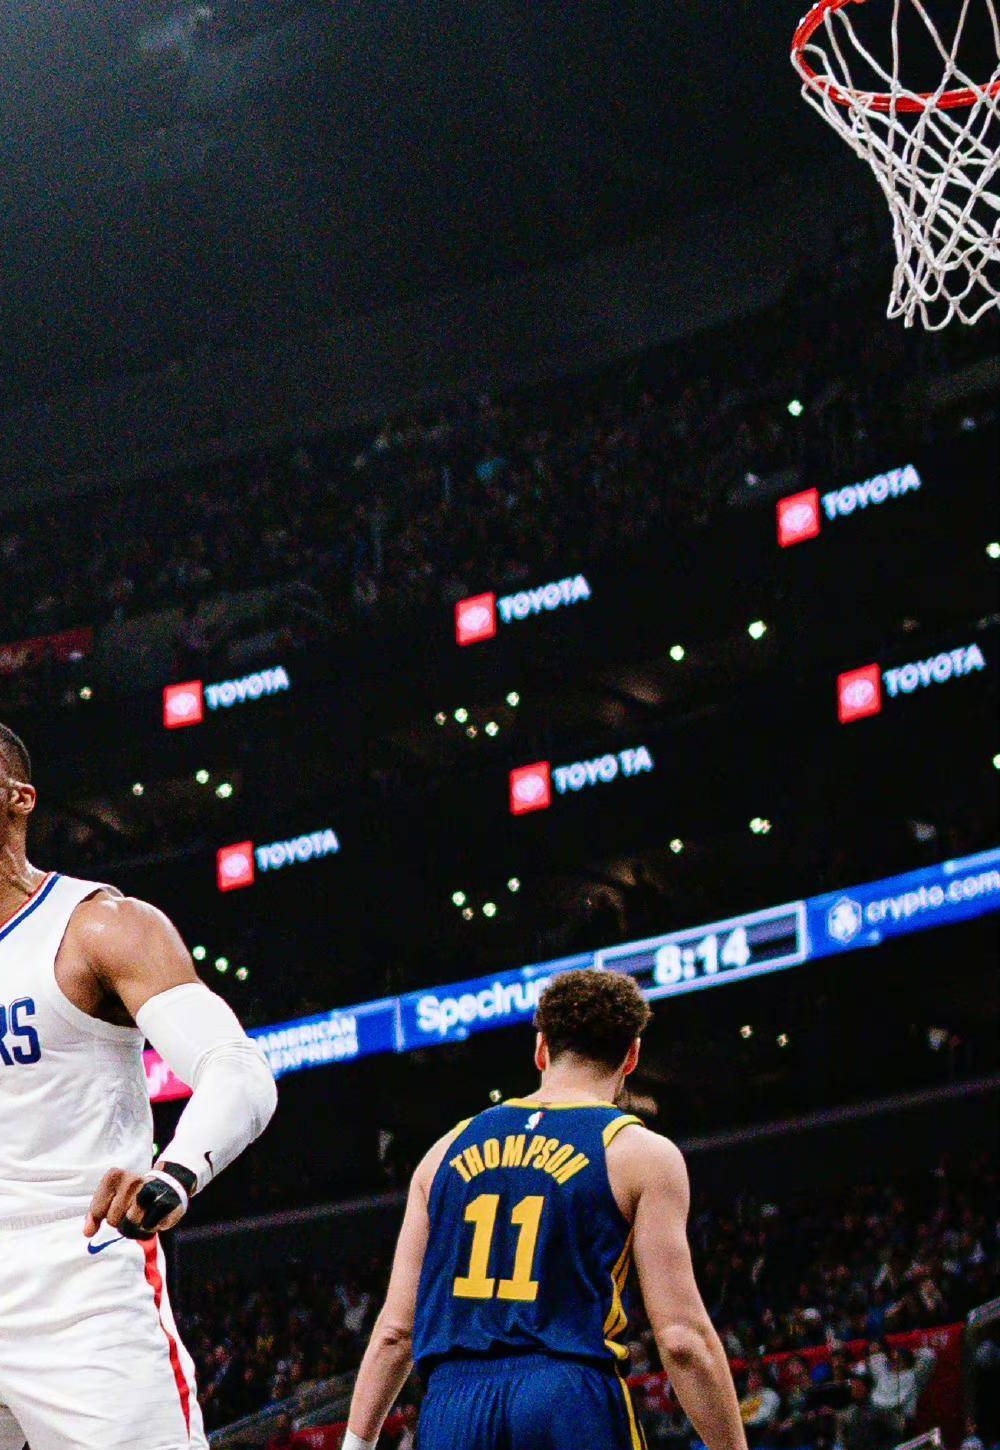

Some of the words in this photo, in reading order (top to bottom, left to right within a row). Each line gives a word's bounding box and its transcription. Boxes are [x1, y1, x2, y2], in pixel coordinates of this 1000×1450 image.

[822, 464, 921, 519] TOYOTA
[499, 574, 591, 623] TOYOTA
[204, 666, 290, 711] TOYOTA
[884, 644, 986, 698] TOYOTA
[256, 829, 339, 873] TOYOTA
[653, 926, 751, 986] 8:14
[450, 1134, 590, 1185] THOMPSON
[453, 1194, 545, 1301] 11
